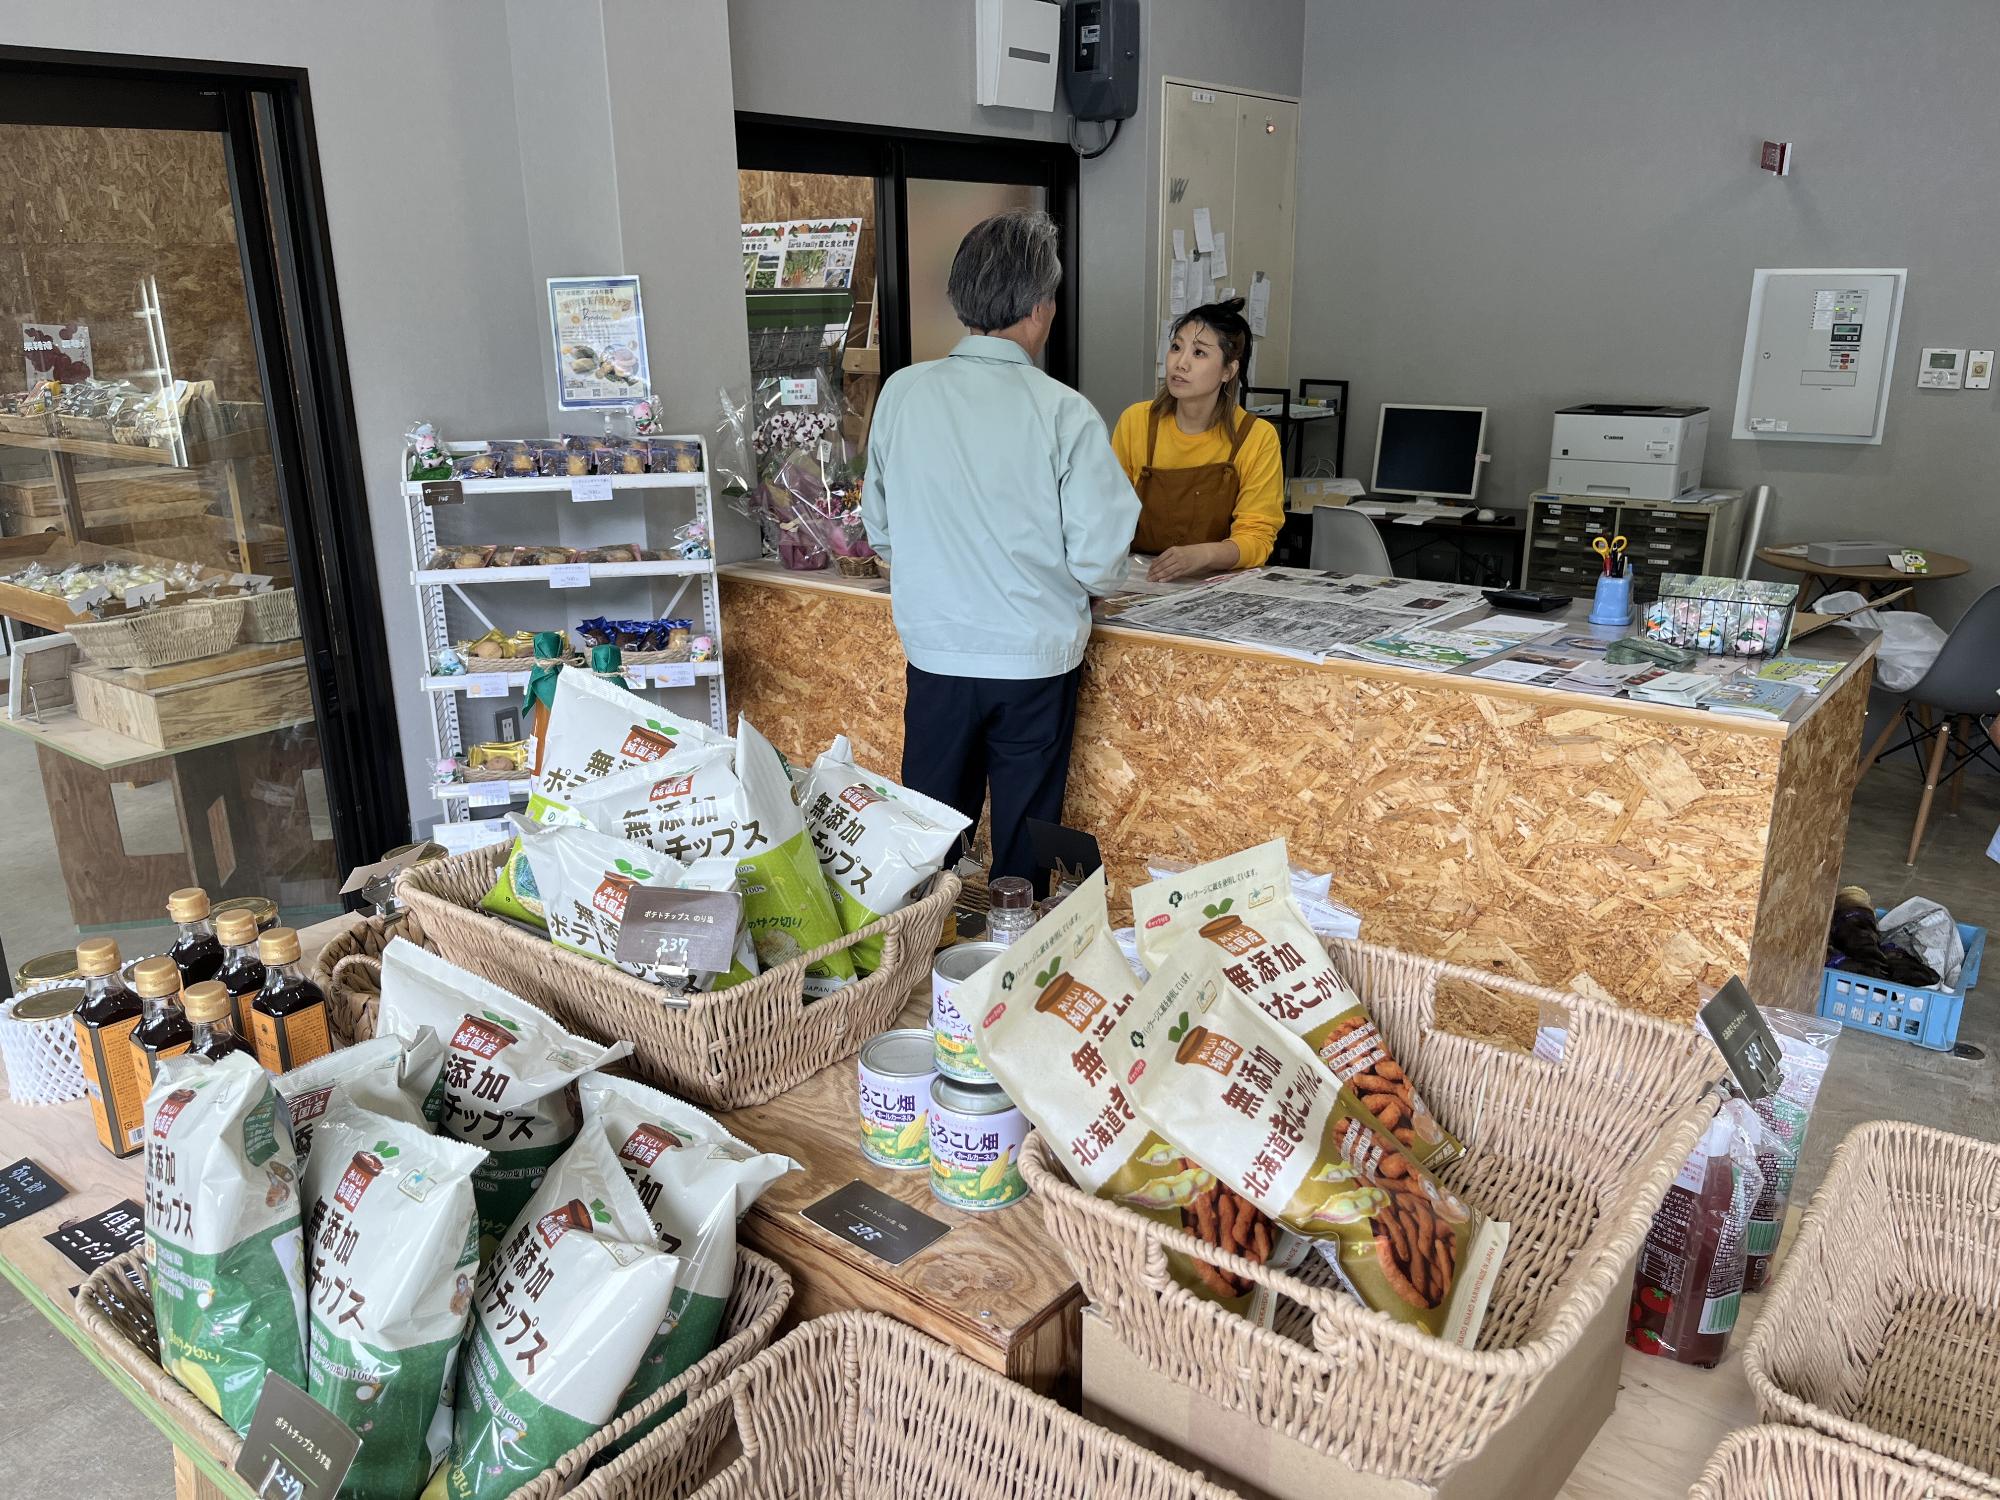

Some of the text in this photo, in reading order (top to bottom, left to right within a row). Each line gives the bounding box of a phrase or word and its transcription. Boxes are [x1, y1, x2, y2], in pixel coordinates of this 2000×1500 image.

[623, 796, 719, 840] 無添加
[809, 791, 867, 848] 無添加
[644, 911, 714, 924] ポテトチップス のり塩
[658, 937, 689, 953] 237
[1222, 941, 1307, 995] 無添加
[453, 1030, 499, 1056] 純国産
[466, 1025, 501, 1044] おいしい
[445, 1053, 511, 1104] 添加
[1221, 1044, 1283, 1120] 無添加
[624, 1140, 659, 1164] 純国産
[929, 1120, 999, 1152] もろこし畑
[955, 1150, 999, 1163] ホールカーネル
[308, 1194, 361, 1268] 無添加
[505, 1221, 555, 1304] 無添加
[274, 1416, 315, 1455] ポテトチップス
